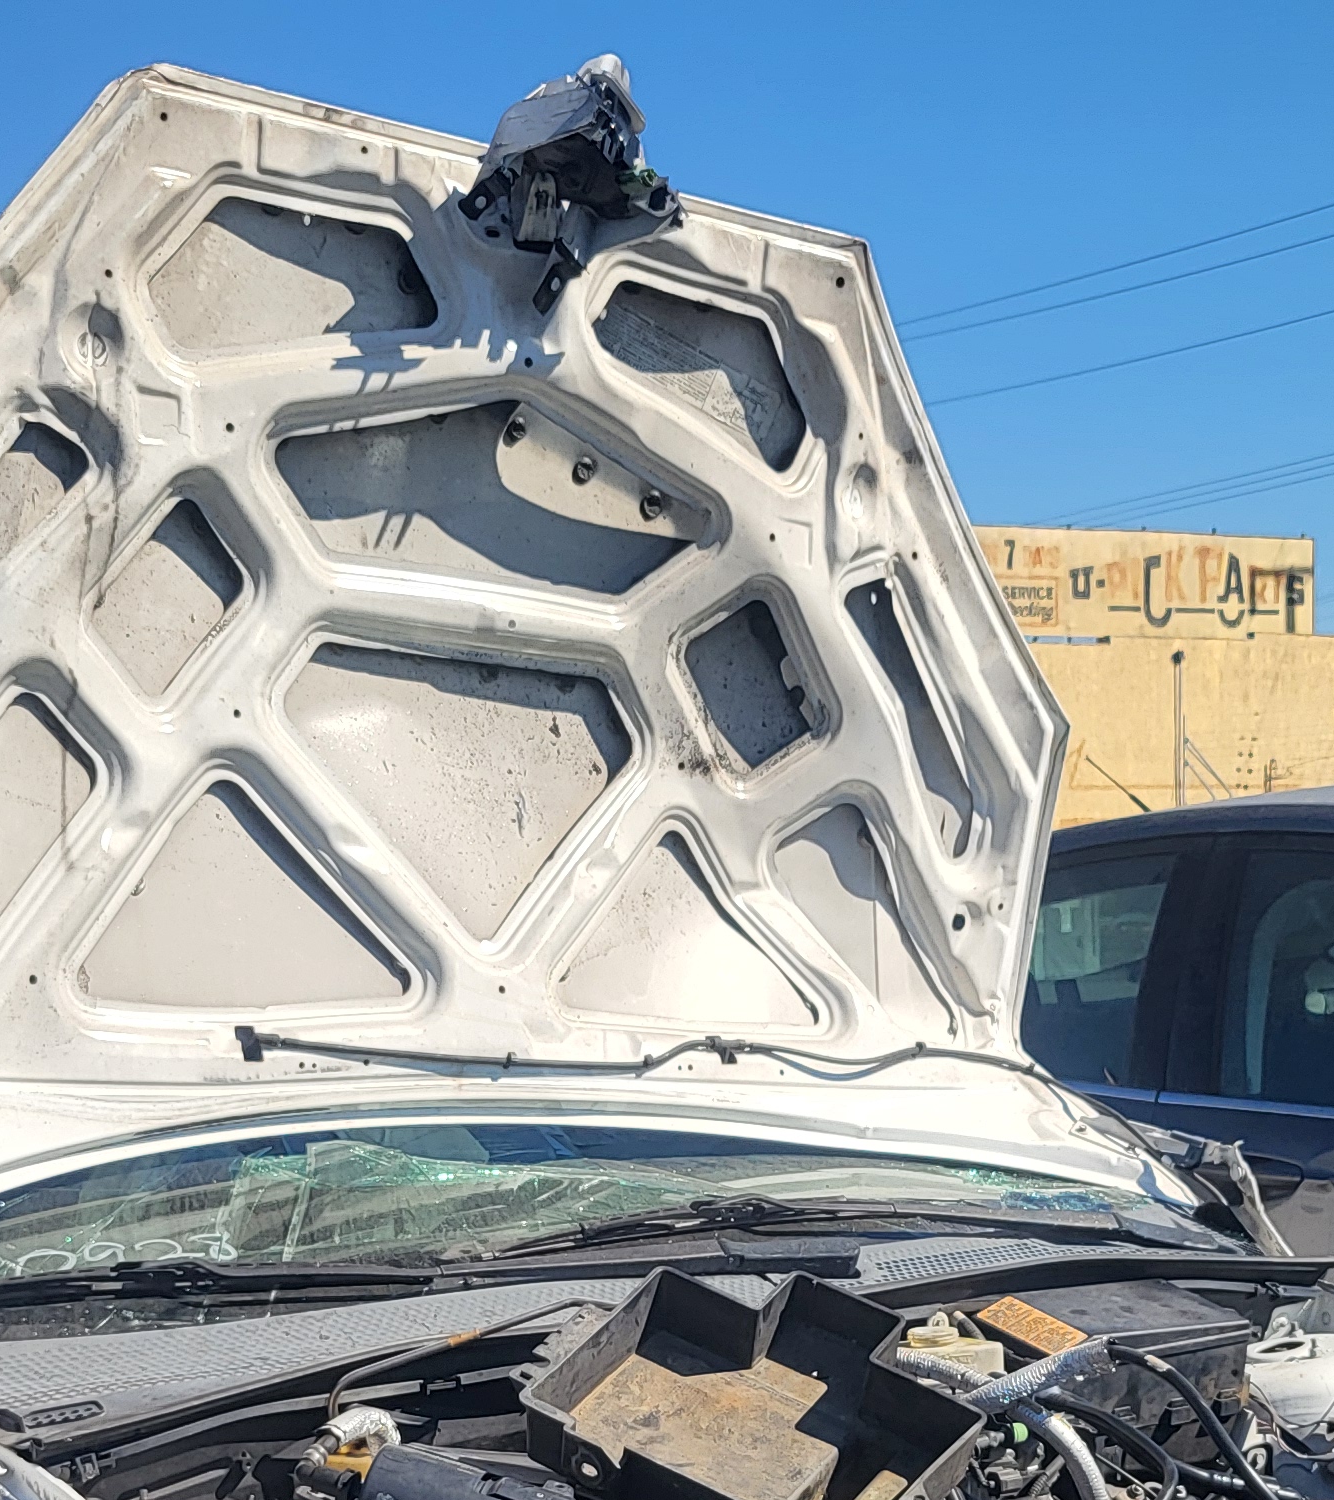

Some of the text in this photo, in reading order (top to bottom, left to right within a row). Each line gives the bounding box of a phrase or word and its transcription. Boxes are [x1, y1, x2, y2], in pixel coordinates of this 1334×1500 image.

[1004, 539, 1016, 570] 7
[1001, 585, 1055, 601] SERVICE
[15, 1231, 239, 1277] 0928
